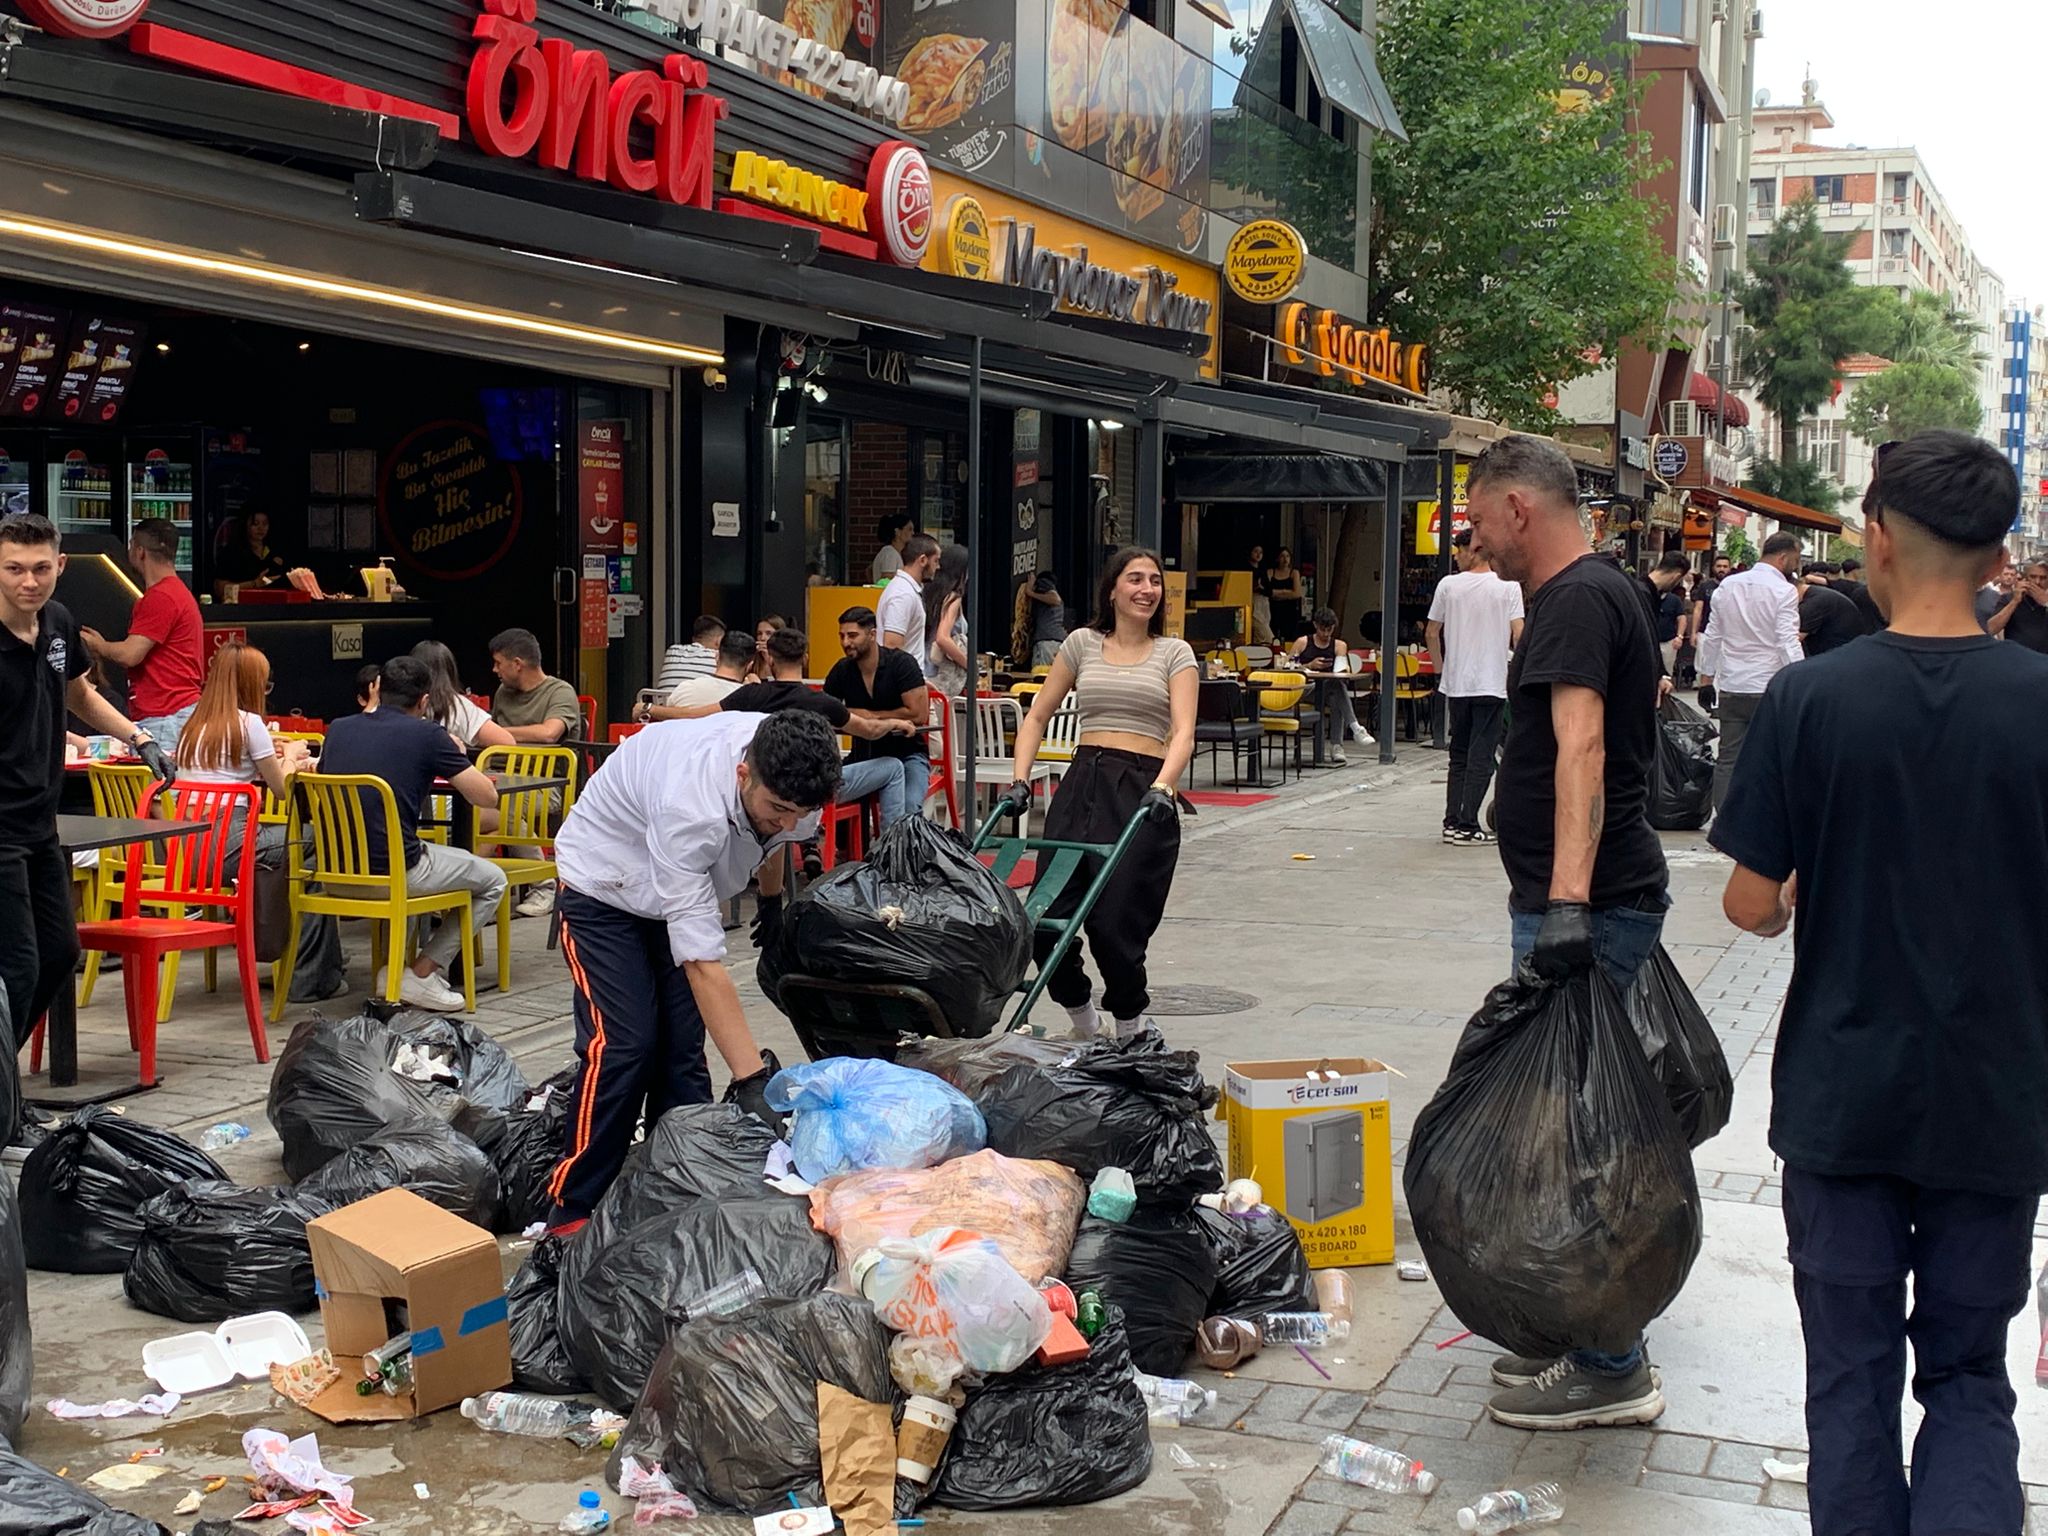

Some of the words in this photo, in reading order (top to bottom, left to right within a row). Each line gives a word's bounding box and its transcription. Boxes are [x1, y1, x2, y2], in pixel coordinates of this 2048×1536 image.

[704, 1, 800, 70] PAKET
[791, 38, 852, 91] 422
[874, 75, 910, 121] 60
[730, 151, 869, 232] ALSANCAK
[1231, 253, 1297, 271] Maydonoz
[1247, 280, 1280, 291] DÖNER
[433, 485, 471, 517] Hiç
[411, 491, 513, 553] Bitmesin!
[1013, 538, 1037, 554] MUTLAKA
[1013, 551, 1037, 576] DENE!
[334, 631, 361, 653] Kasa
[1317, 1226, 1337, 1238] 420
[1349, 1224, 1366, 1236] 180
[1320, 1240, 1357, 1252] BOARD
